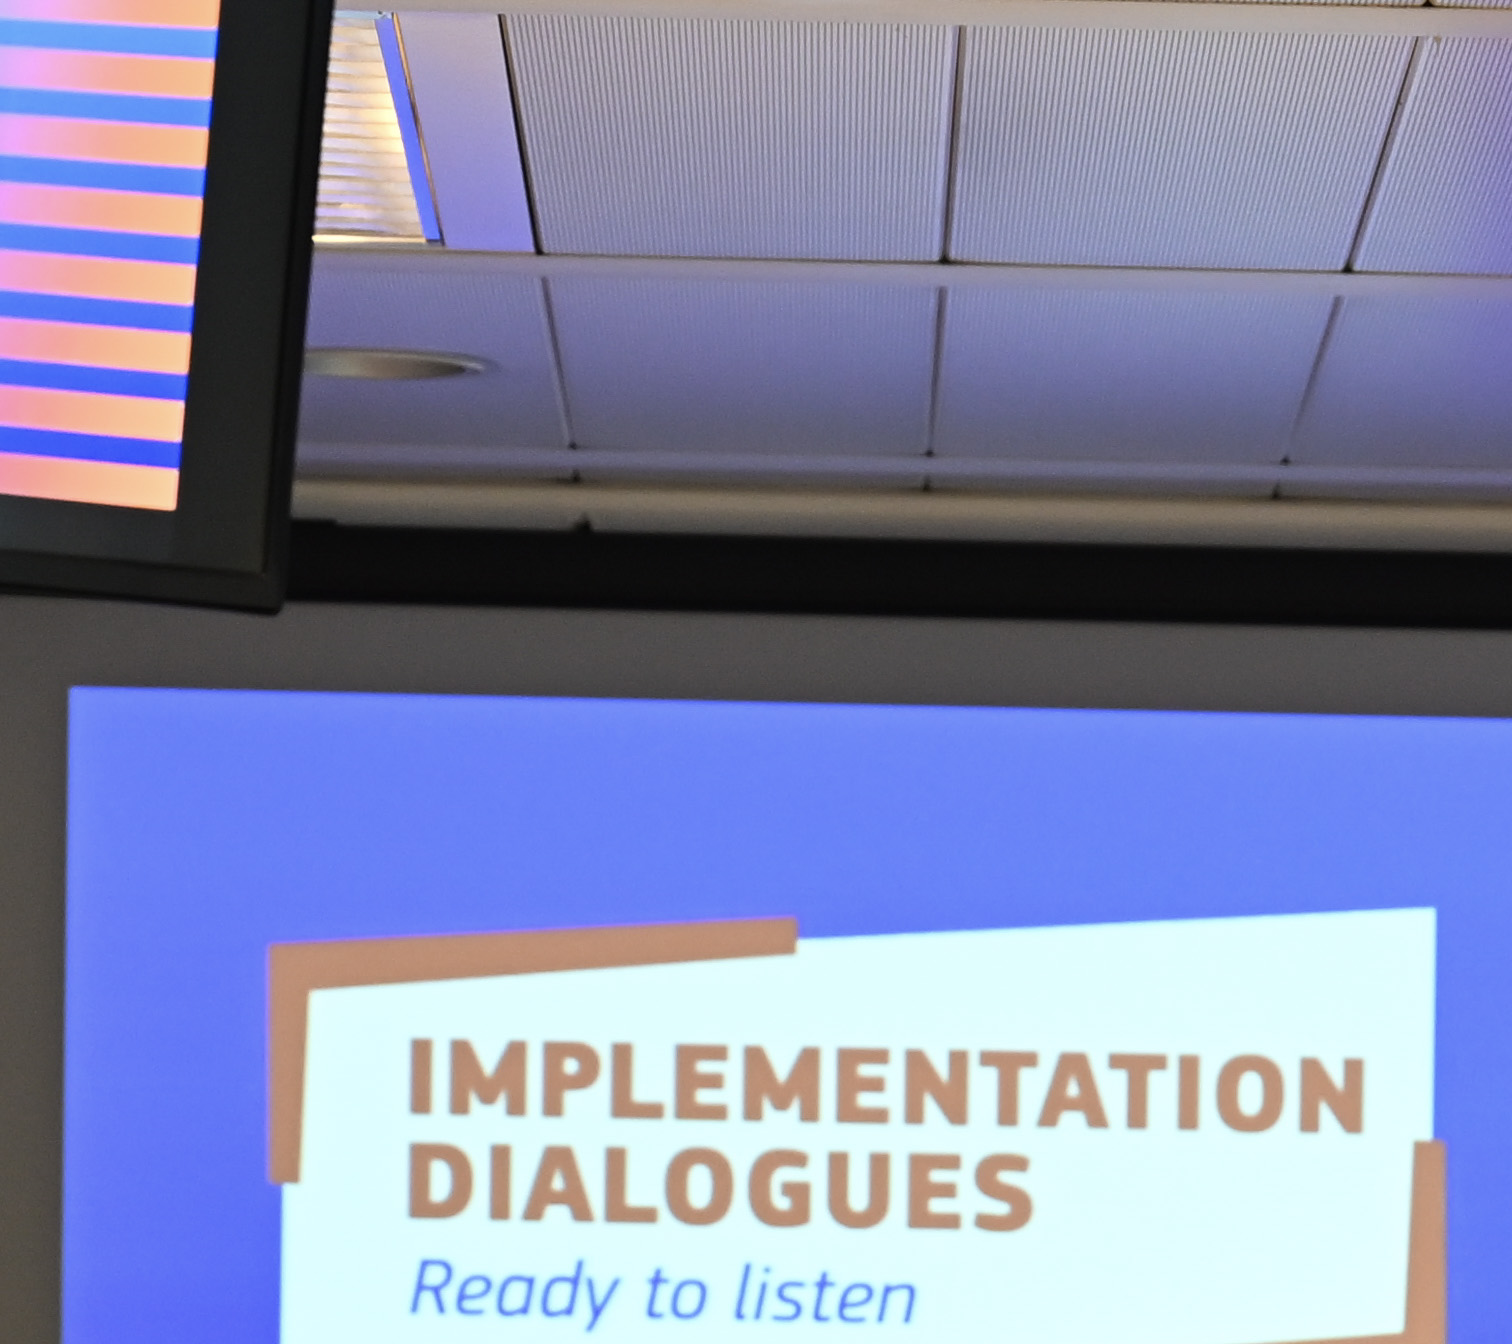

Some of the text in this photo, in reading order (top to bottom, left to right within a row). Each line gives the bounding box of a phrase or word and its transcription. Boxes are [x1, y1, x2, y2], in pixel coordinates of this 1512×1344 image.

[407, 1037, 1368, 1134] IMPLEMENTATION
[405, 1141, 1037, 1233] DIALOGUES
[408, 1259, 918, 1332] Ready to listen
